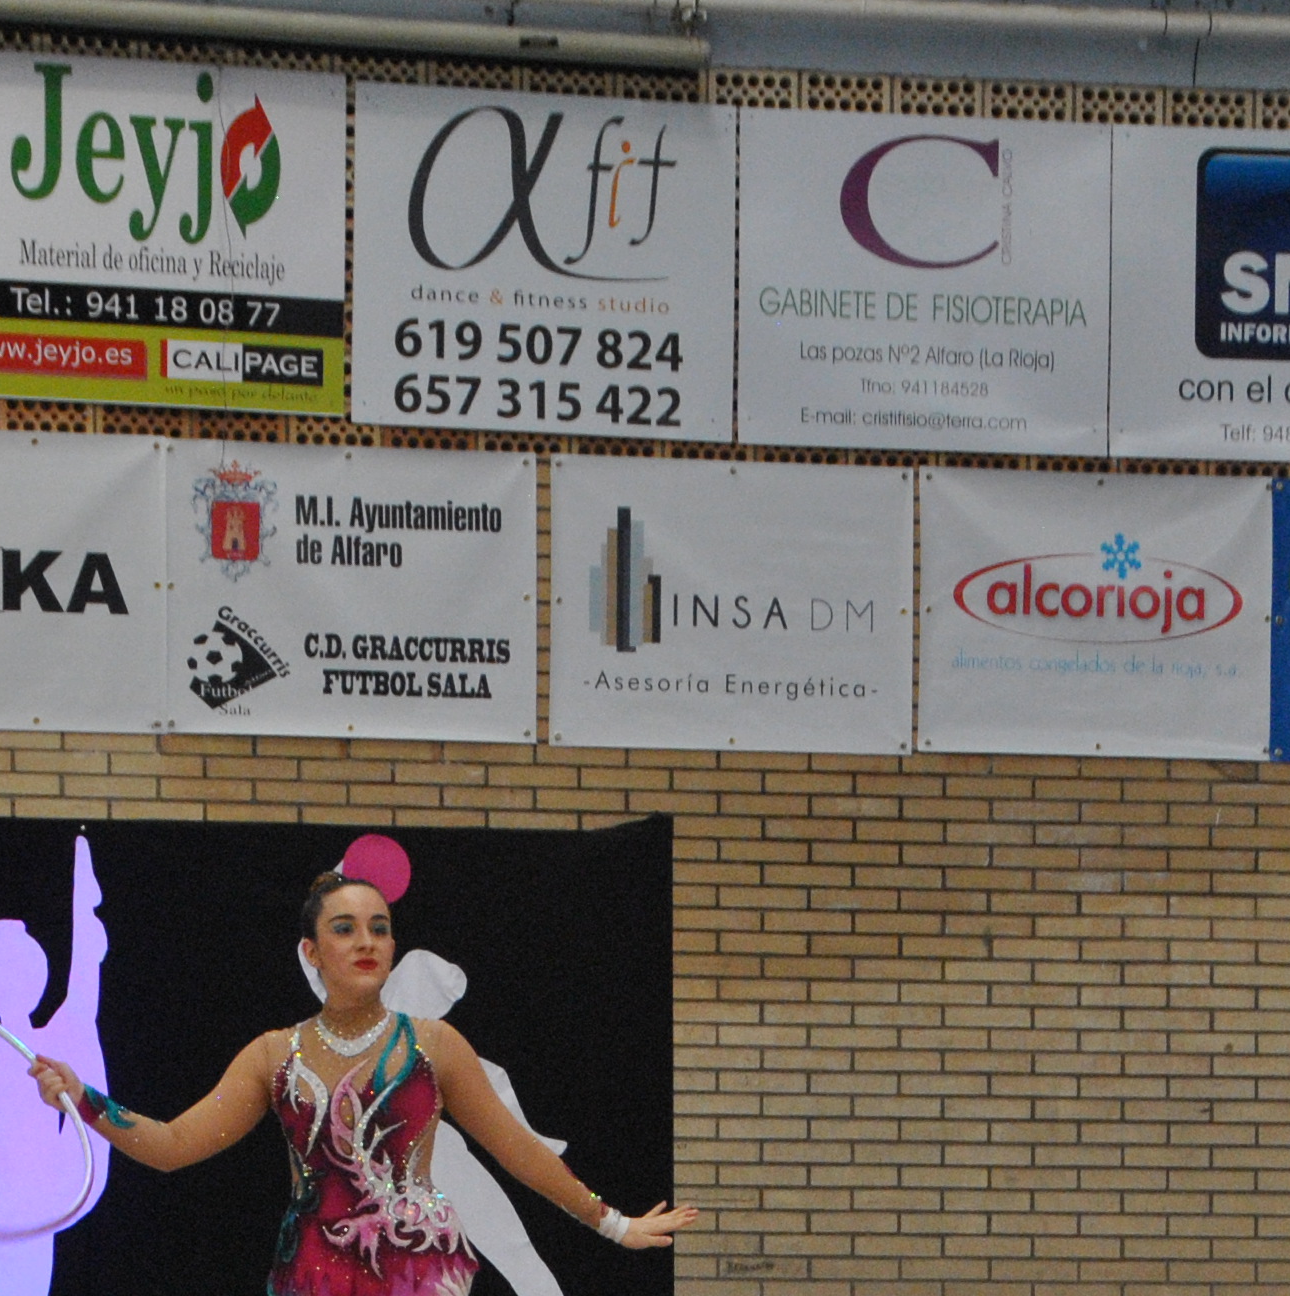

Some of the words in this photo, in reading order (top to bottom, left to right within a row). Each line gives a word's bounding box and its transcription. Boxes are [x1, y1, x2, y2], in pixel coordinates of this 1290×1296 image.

[840, 134, 999, 269] C
[19, 238, 97, 269] Material
[102, 243, 123, 271] de
[129, 246, 187, 276] oficina
[192, 256, 203, 281] y
[209, 250, 286, 287] Reciclaje
[10, 287, 72, 317] Tel.:
[86, 290, 139, 319] 941
[154, 295, 188, 322] 18
[199, 298, 235, 325] 08
[245, 301, 282, 328] 77
[411, 284, 479, 304] dance
[489, 288, 504, 305] &
[513, 289, 588, 310] fitness
[598, 295, 670, 315] studio
[759, 287, 877, 321] GABINETE
[887, 291, 919, 322] DE
[933, 294, 1088, 328] FISIOTERAPIA
[394, 317, 483, 361] 619
[497, 322, 583, 367] 507
[596, 328, 685, 372] 824
[800, 341, 827, 361] Las
[832, 345, 884, 366] pozas
[926, 346, 975, 368] Alfaro
[979, 348, 1004, 371] (La
[1009, 348, 1056, 373] Rioja)
[172, 348, 320, 378] CALIPAGE
[393, 373, 482, 416] 657
[496, 378, 583, 422] 315
[595, 383, 683, 428] 422
[902, 379, 989, 398] 941184528
[1178, 378, 1235, 404] con
[1246, 375, 1272, 405] el
[800, 407, 857, 426] E-mail:
[1220, 424, 1256, 444] Telf:
[294, 495, 341, 528] M.I.
[349, 496, 502, 533] Ayuntamiento
[296, 534, 323, 565] de
[330, 534, 403, 568] Alfaro
[672, 592, 788, 630] INSA
[810, 597, 874, 633] DM
[986, 563, 1206, 634] alcorioja
[304, 632, 347, 660] C.D.
[352, 635, 511, 664] GRACCURRIS
[951, 648, 1022, 670] alimentos
[1028, 650, 1116, 675] congelados
[1123, 654, 1146, 674] de
[322, 668, 423, 698] FUTBOL
[427, 672, 492, 699] SALA
[218, 703, 251, 716] Sala
